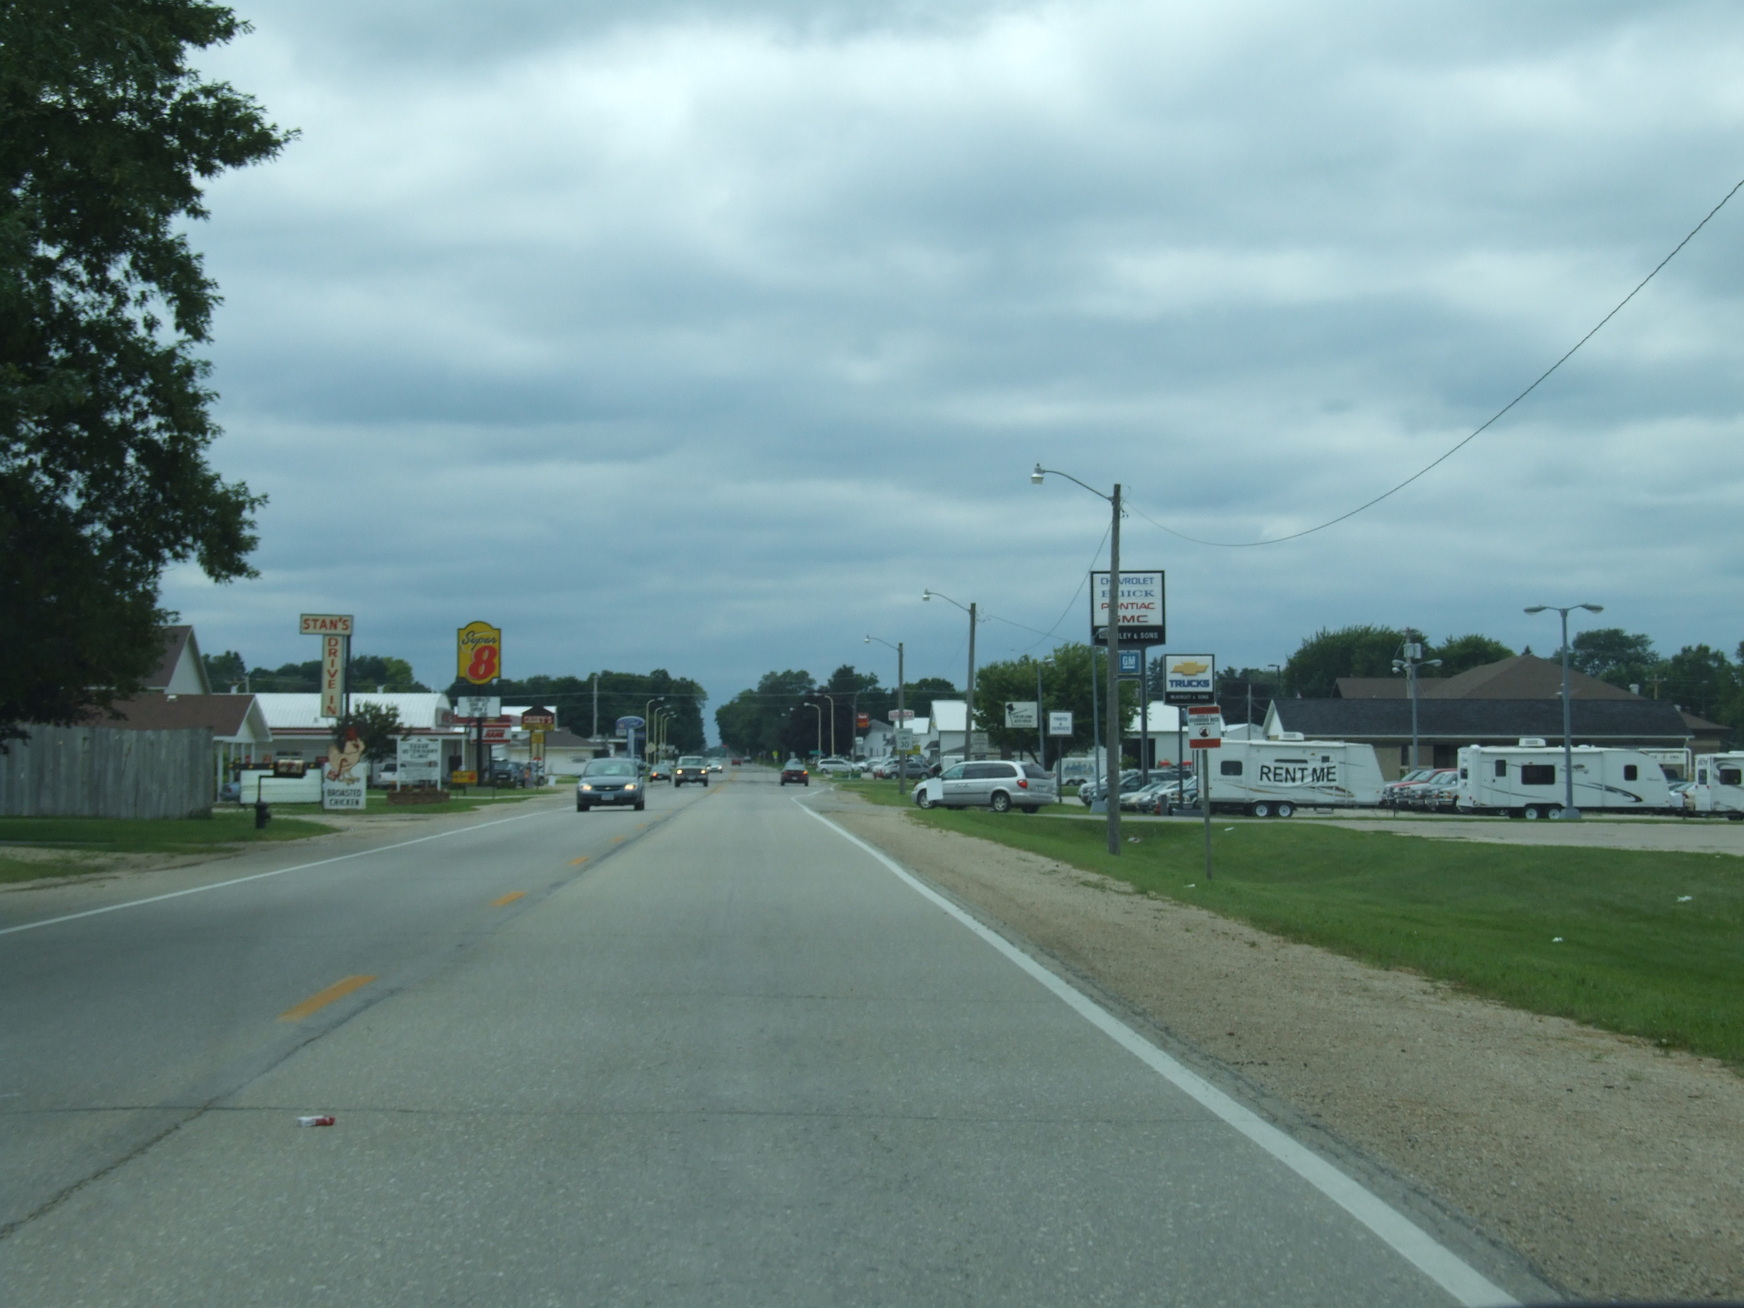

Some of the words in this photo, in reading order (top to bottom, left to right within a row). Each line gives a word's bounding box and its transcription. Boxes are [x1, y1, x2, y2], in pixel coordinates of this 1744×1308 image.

[1100, 577, 1155, 585] CHVROLET
[1101, 602, 1155, 610] PNTIAC
[303, 617, 350, 631] STAN'S
[461, 631, 497, 651] Super
[327, 637, 339, 689] DRIVE
[466, 645, 498, 680] 8
[1122, 655, 1136, 664] GM
[1169, 679, 1210, 688] TRUCKS
[327, 695, 337, 713] IN
[1260, 764, 1308, 783] RENT
[1312, 766, 1336, 783] ME
[327, 788, 361, 797] BROASTED
[329, 799, 359, 807] CHICKEN
